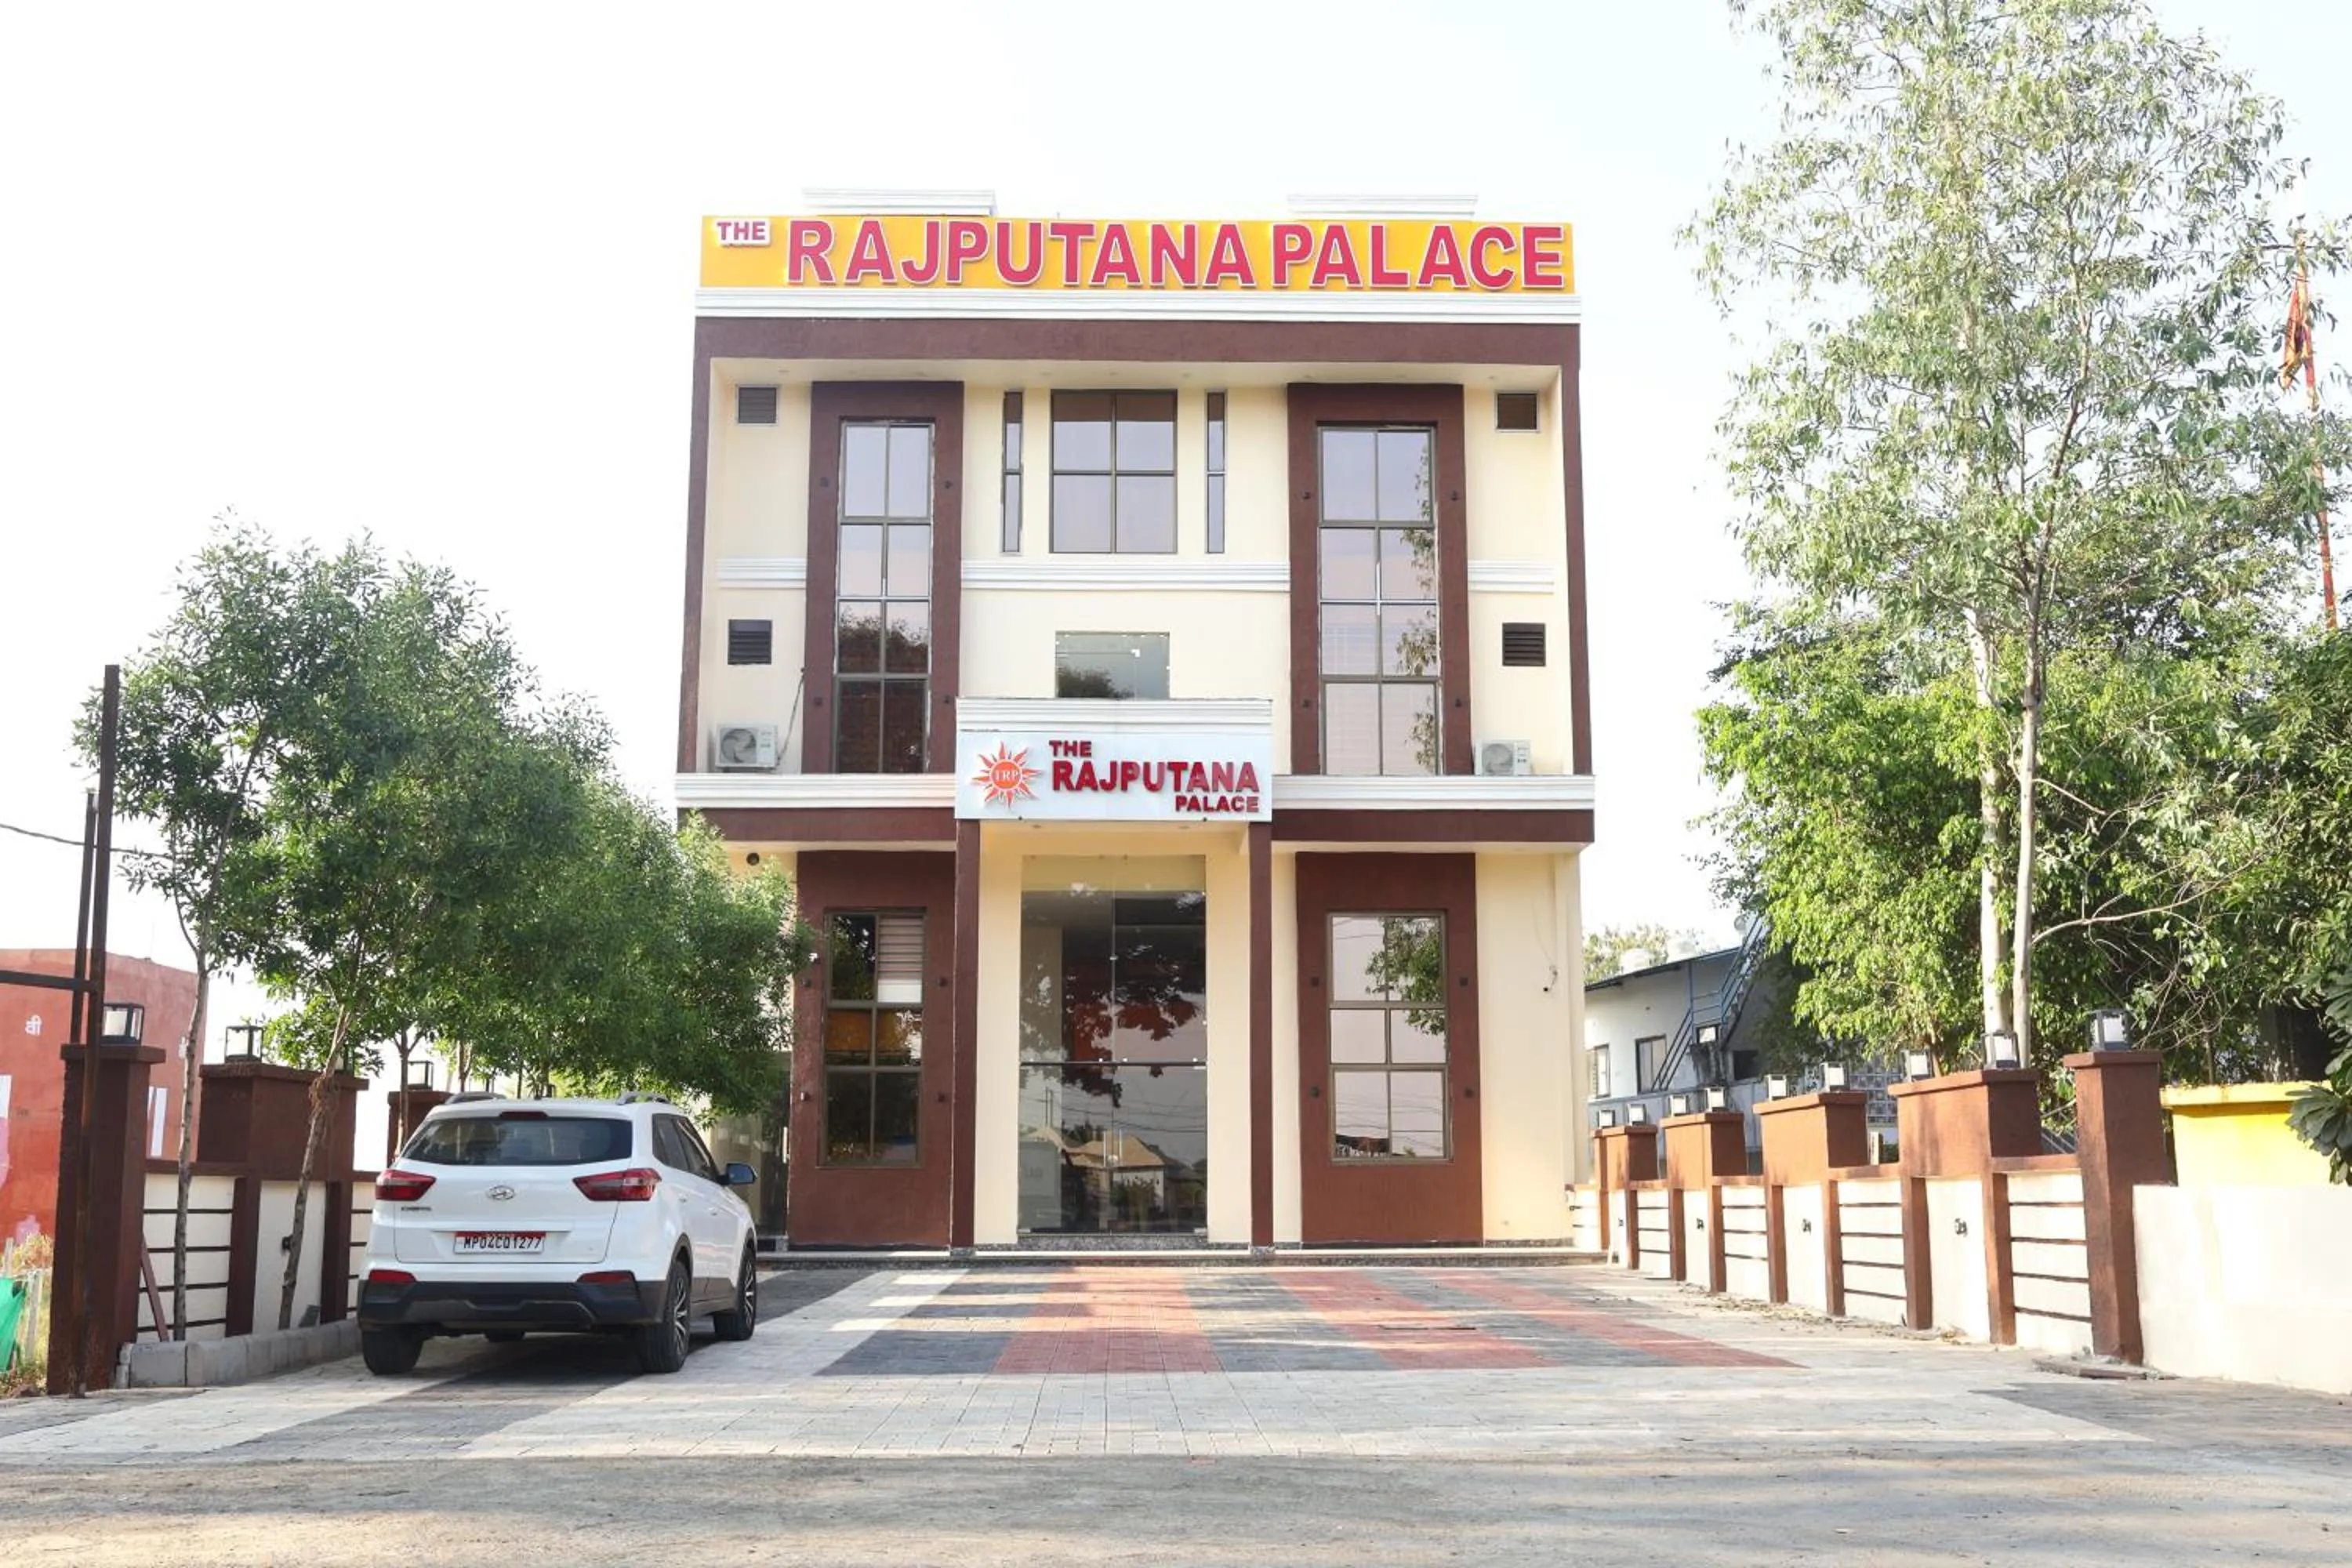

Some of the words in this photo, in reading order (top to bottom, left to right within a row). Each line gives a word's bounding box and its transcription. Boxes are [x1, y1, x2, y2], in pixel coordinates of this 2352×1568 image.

[717, 221, 766, 241] THE
[787, 219, 1257, 288] RAJPUTANA
[1272, 223, 1564, 289] PALACE
[1049, 739, 1092, 757] THE
[1052, 760, 1260, 793] RAJPUTANA
[1175, 795, 1260, 812] PALACE
